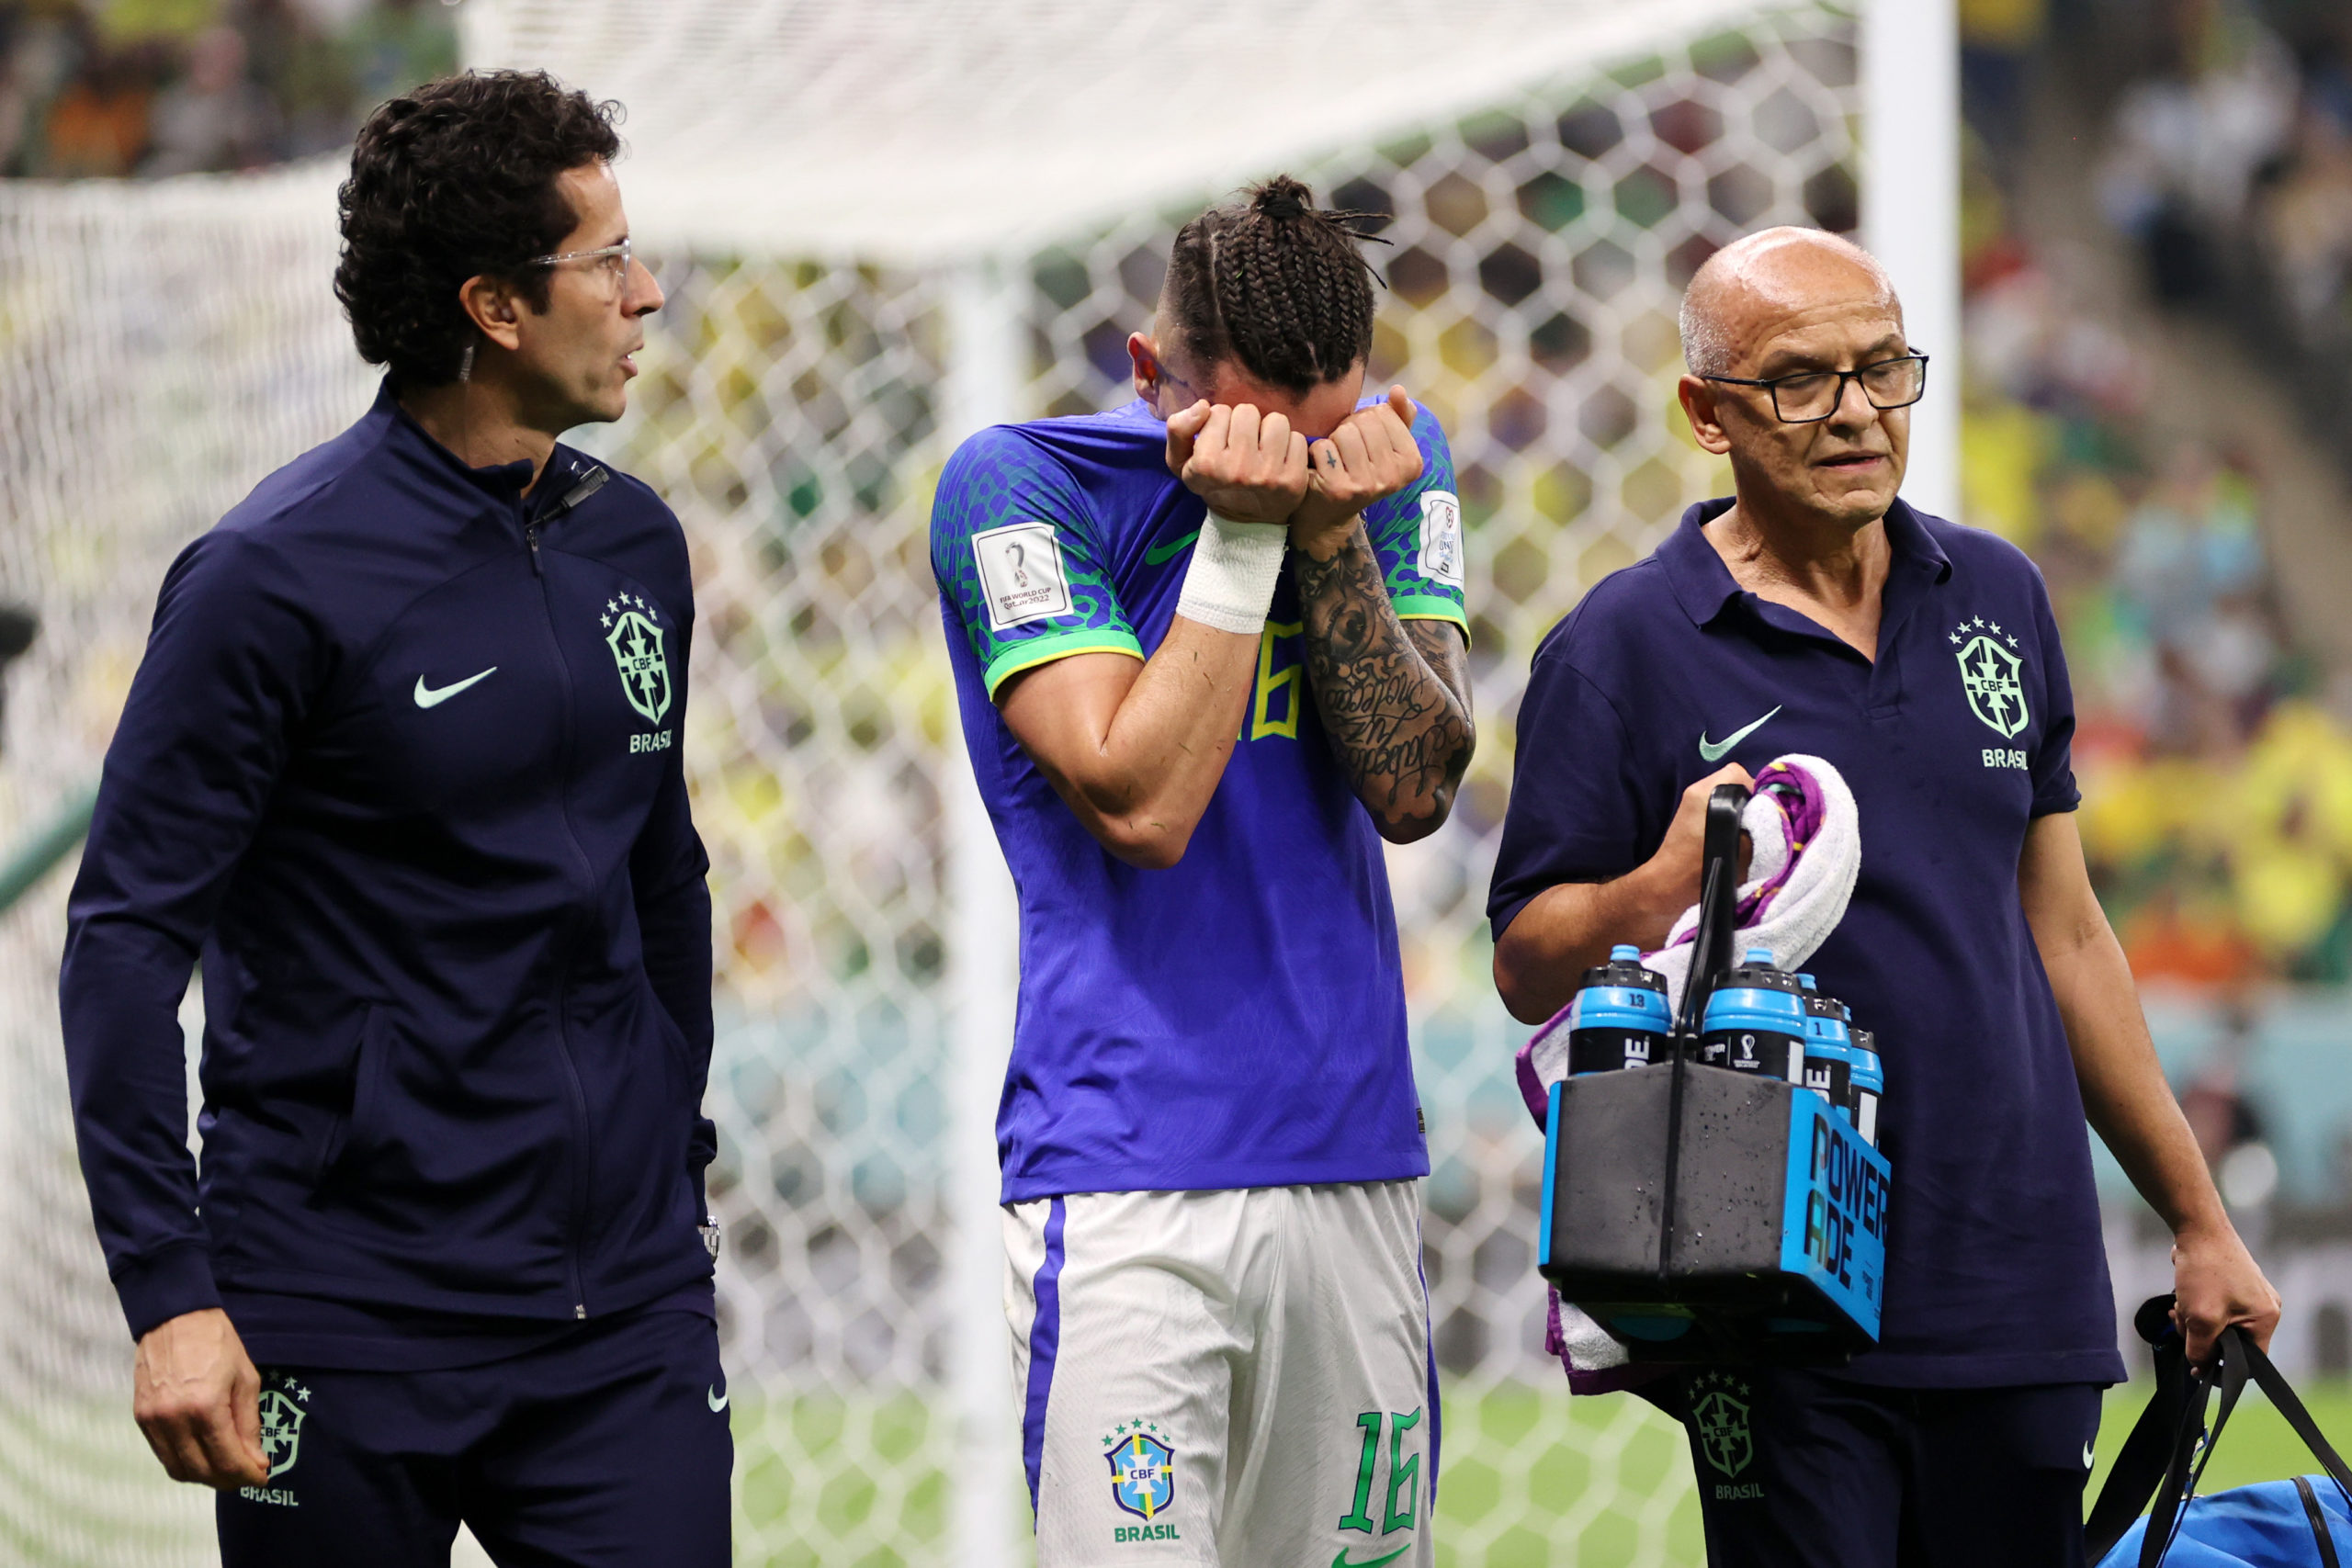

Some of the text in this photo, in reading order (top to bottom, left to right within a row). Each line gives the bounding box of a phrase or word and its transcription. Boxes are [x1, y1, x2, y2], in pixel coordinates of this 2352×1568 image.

[1000, 587, 1052, 604] FIFA WORLD CUP
[632, 657, 652, 671] CBF
[1981, 680, 2004, 693] CBF
[629, 728, 672, 754] BRASIL
[1982, 748, 2029, 771] BRASIL
[1629, 993, 1645, 1009] 13
[1814, 1021, 1823, 1036] 1
[1810, 1112, 1891, 1247] POWER
[1804, 1189, 1855, 1291] ADE
[1713, 1426, 1734, 1438] CBF
[1130, 1468, 1155, 1480] CBF
[1339, 1405, 1420, 1536] 16
[240, 1485, 300, 1507] BRASIL
[1715, 1483, 1765, 1500] BRASIL
[1114, 1523, 1181, 1543] BRASIL
